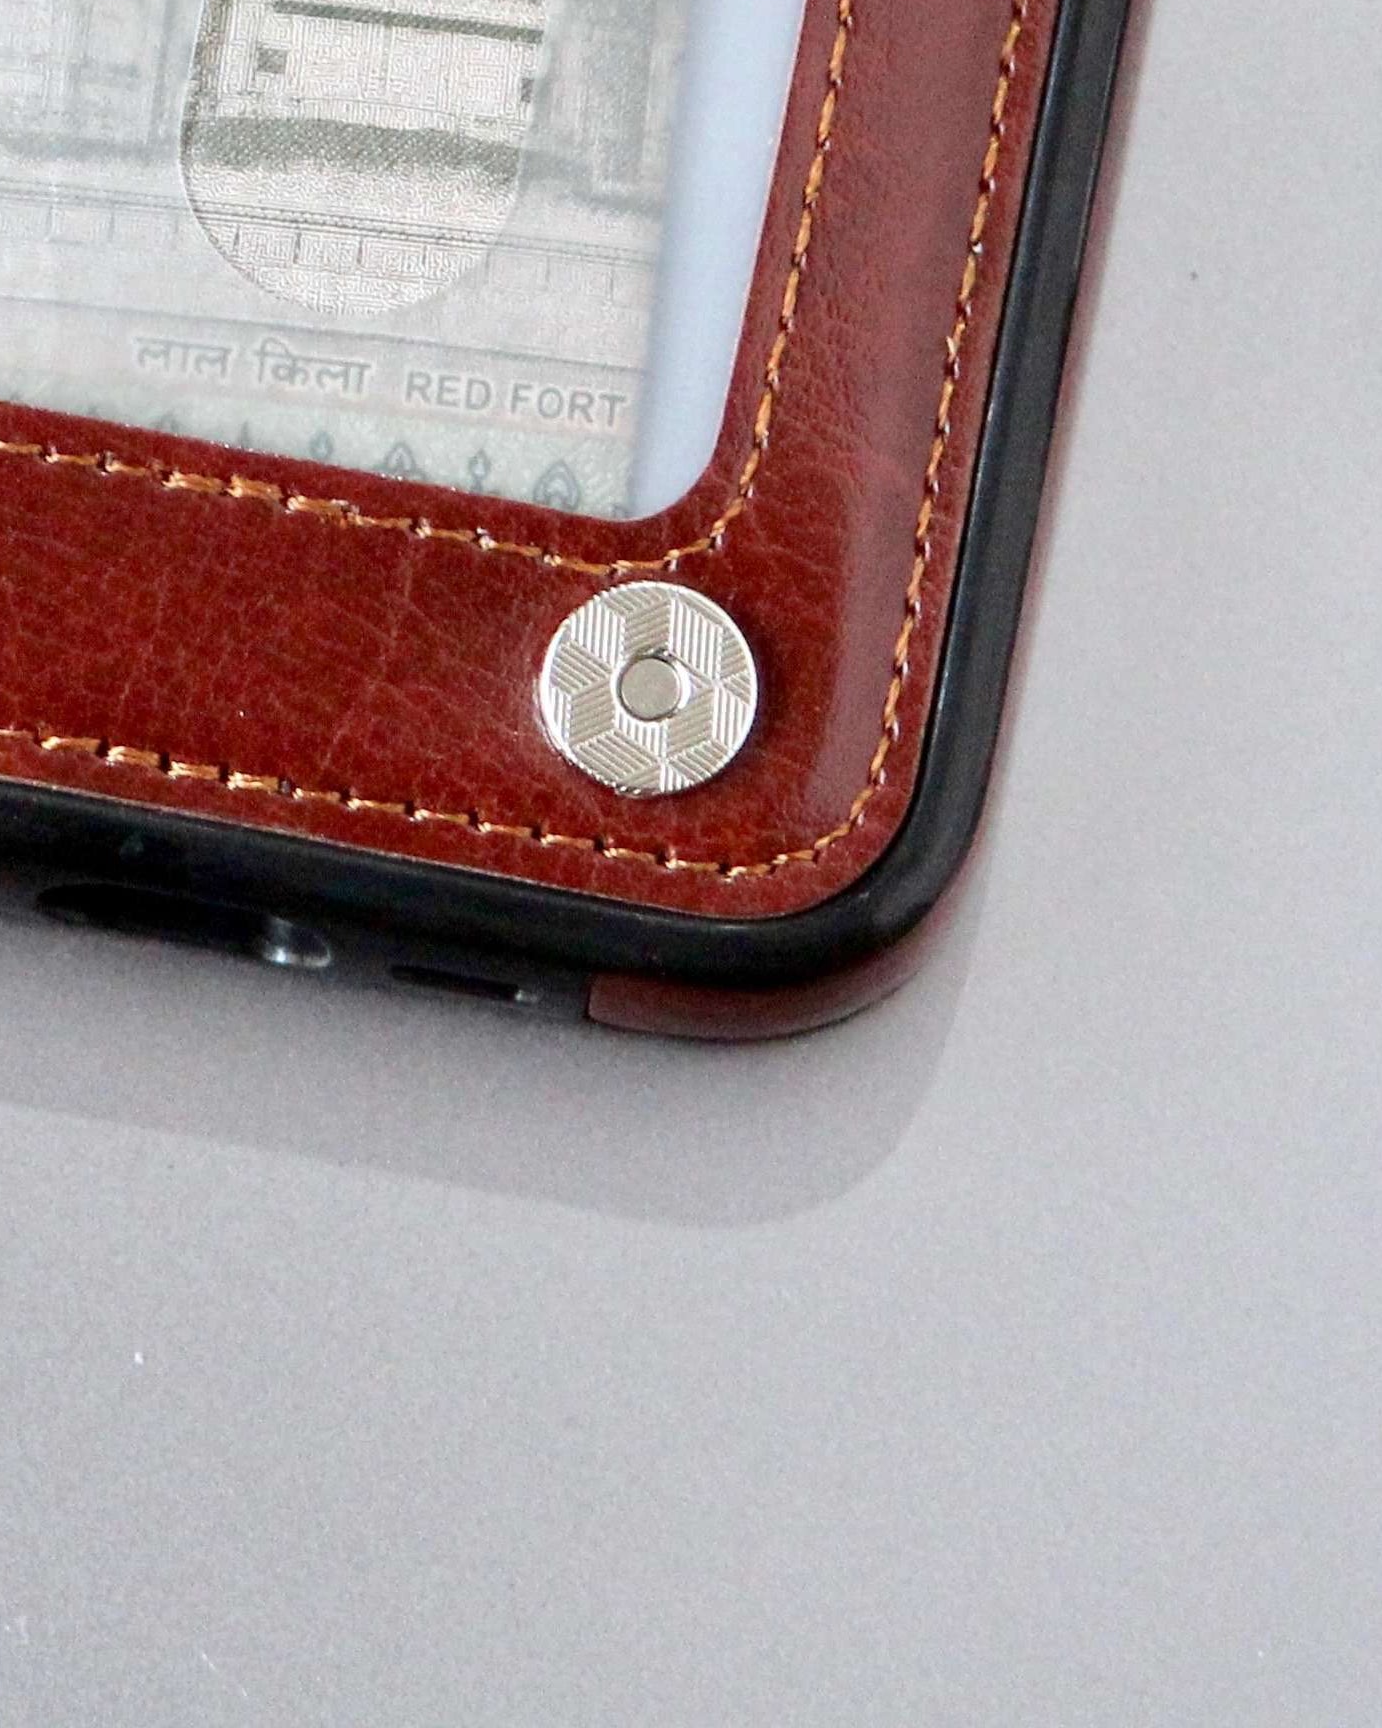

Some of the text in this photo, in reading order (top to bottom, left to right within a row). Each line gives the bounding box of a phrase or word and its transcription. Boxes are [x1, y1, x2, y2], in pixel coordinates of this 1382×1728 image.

[135, 335, 373, 394] लाल किला
[404, 369, 627, 427] RED FORT
